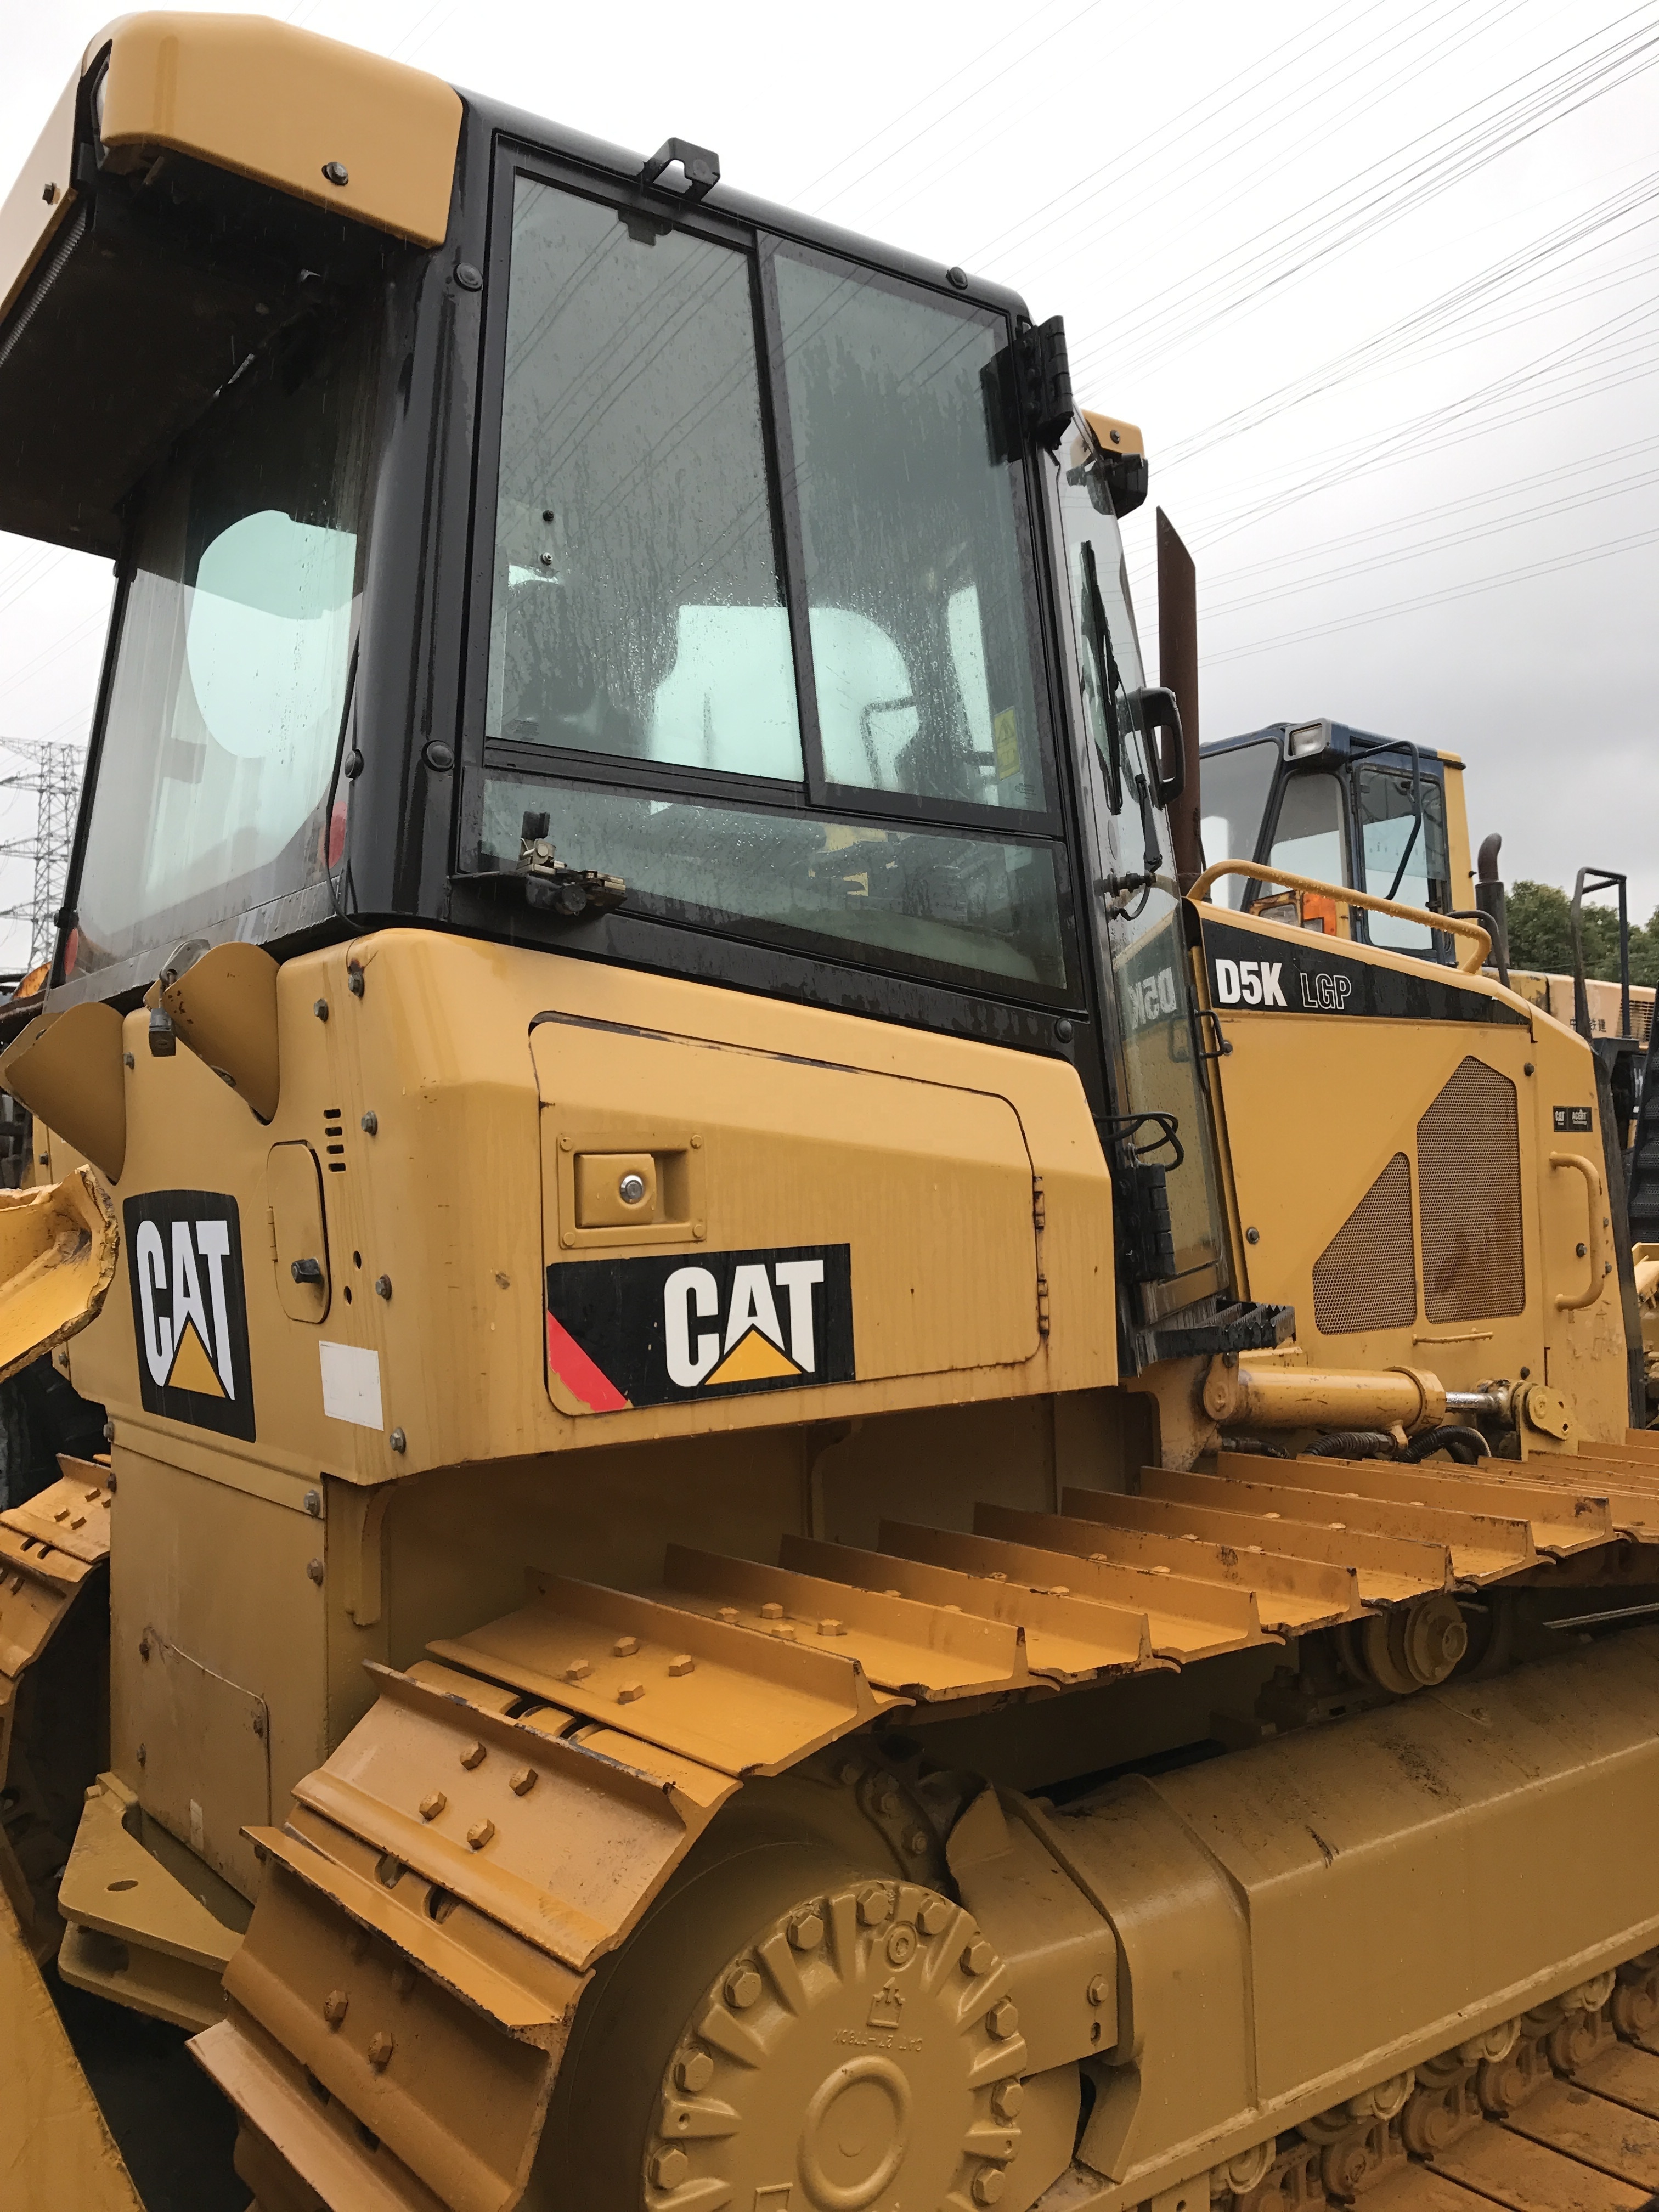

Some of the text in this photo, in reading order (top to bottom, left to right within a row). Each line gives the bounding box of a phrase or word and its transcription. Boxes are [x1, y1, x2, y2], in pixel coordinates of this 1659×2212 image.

[1216, 959, 1351, 1009] D5K LGP
[1555, 1111, 1565, 1121] CAT
[137, 1220, 235, 1400] CAT
[664, 1260, 824, 1387] CAT
